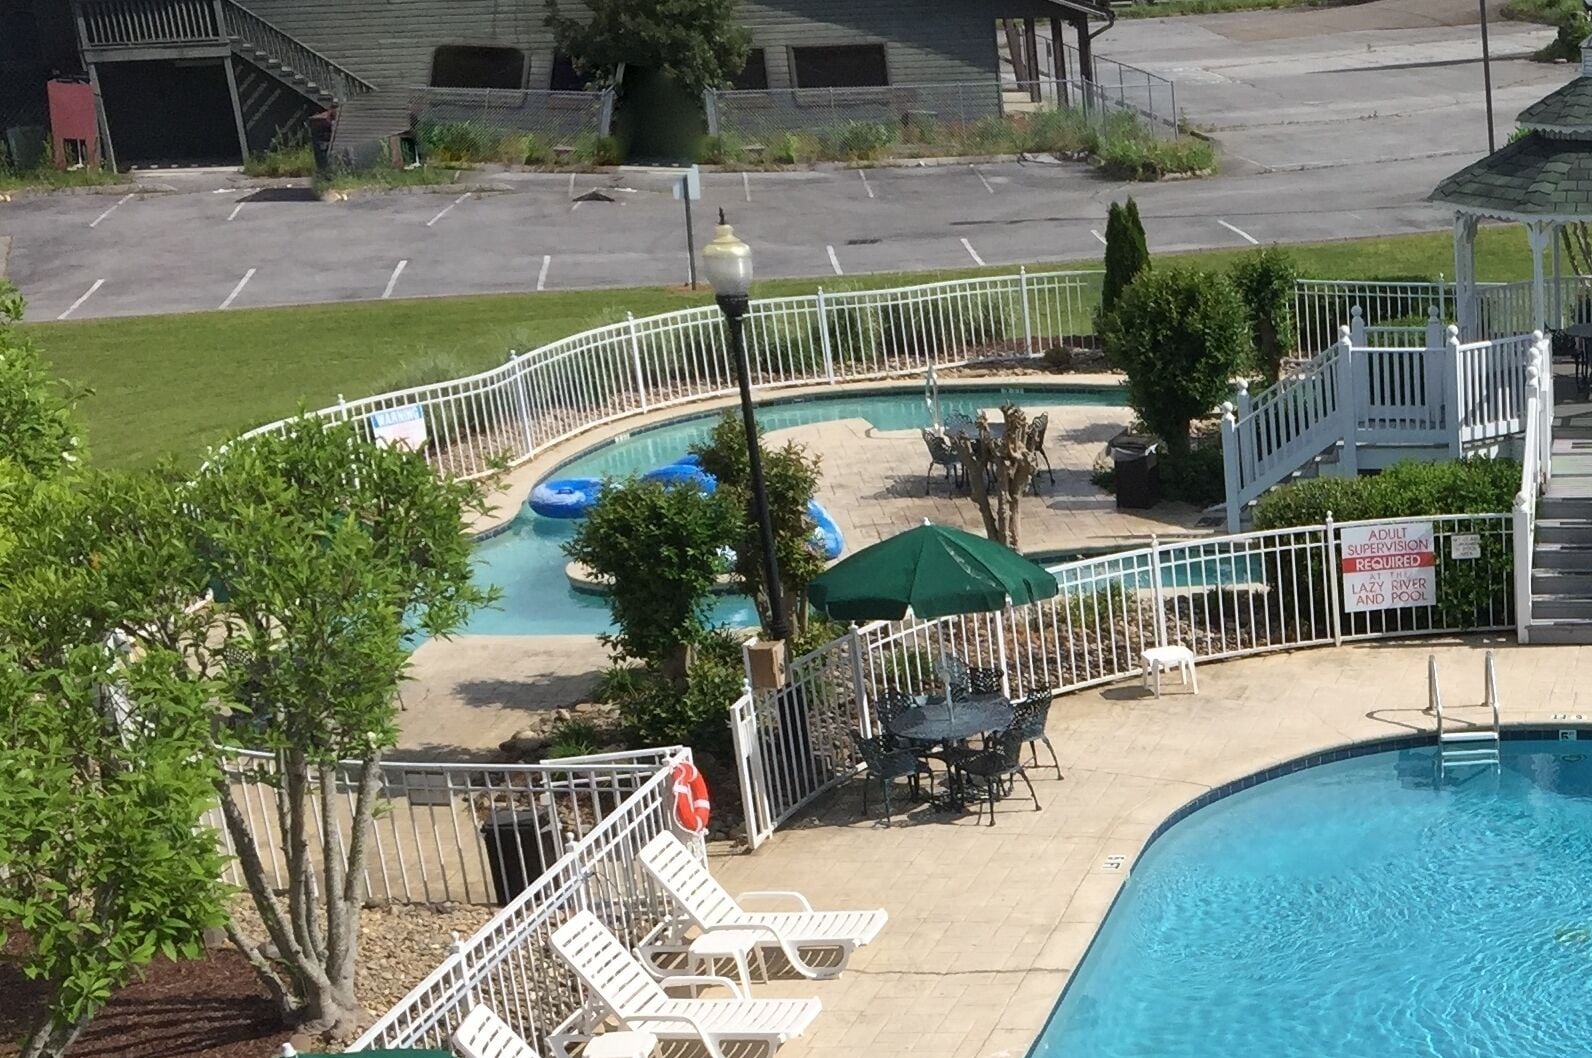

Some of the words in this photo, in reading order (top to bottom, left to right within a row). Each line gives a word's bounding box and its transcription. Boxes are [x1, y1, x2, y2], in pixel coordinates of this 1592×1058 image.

[1368, 528, 1408, 541] ADULT
[1348, 539, 1429, 556] SUPERVISION
[1356, 555, 1420, 571] REQUIRED
[1369, 572, 1381, 580] AT
[1389, 571, 1411, 579] THE
[1352, 581, 1385, 595] LAZY
[1391, 578, 1427, 591] RIVER
[1356, 593, 1385, 606] AND
[1391, 590, 1427, 604] POOL
